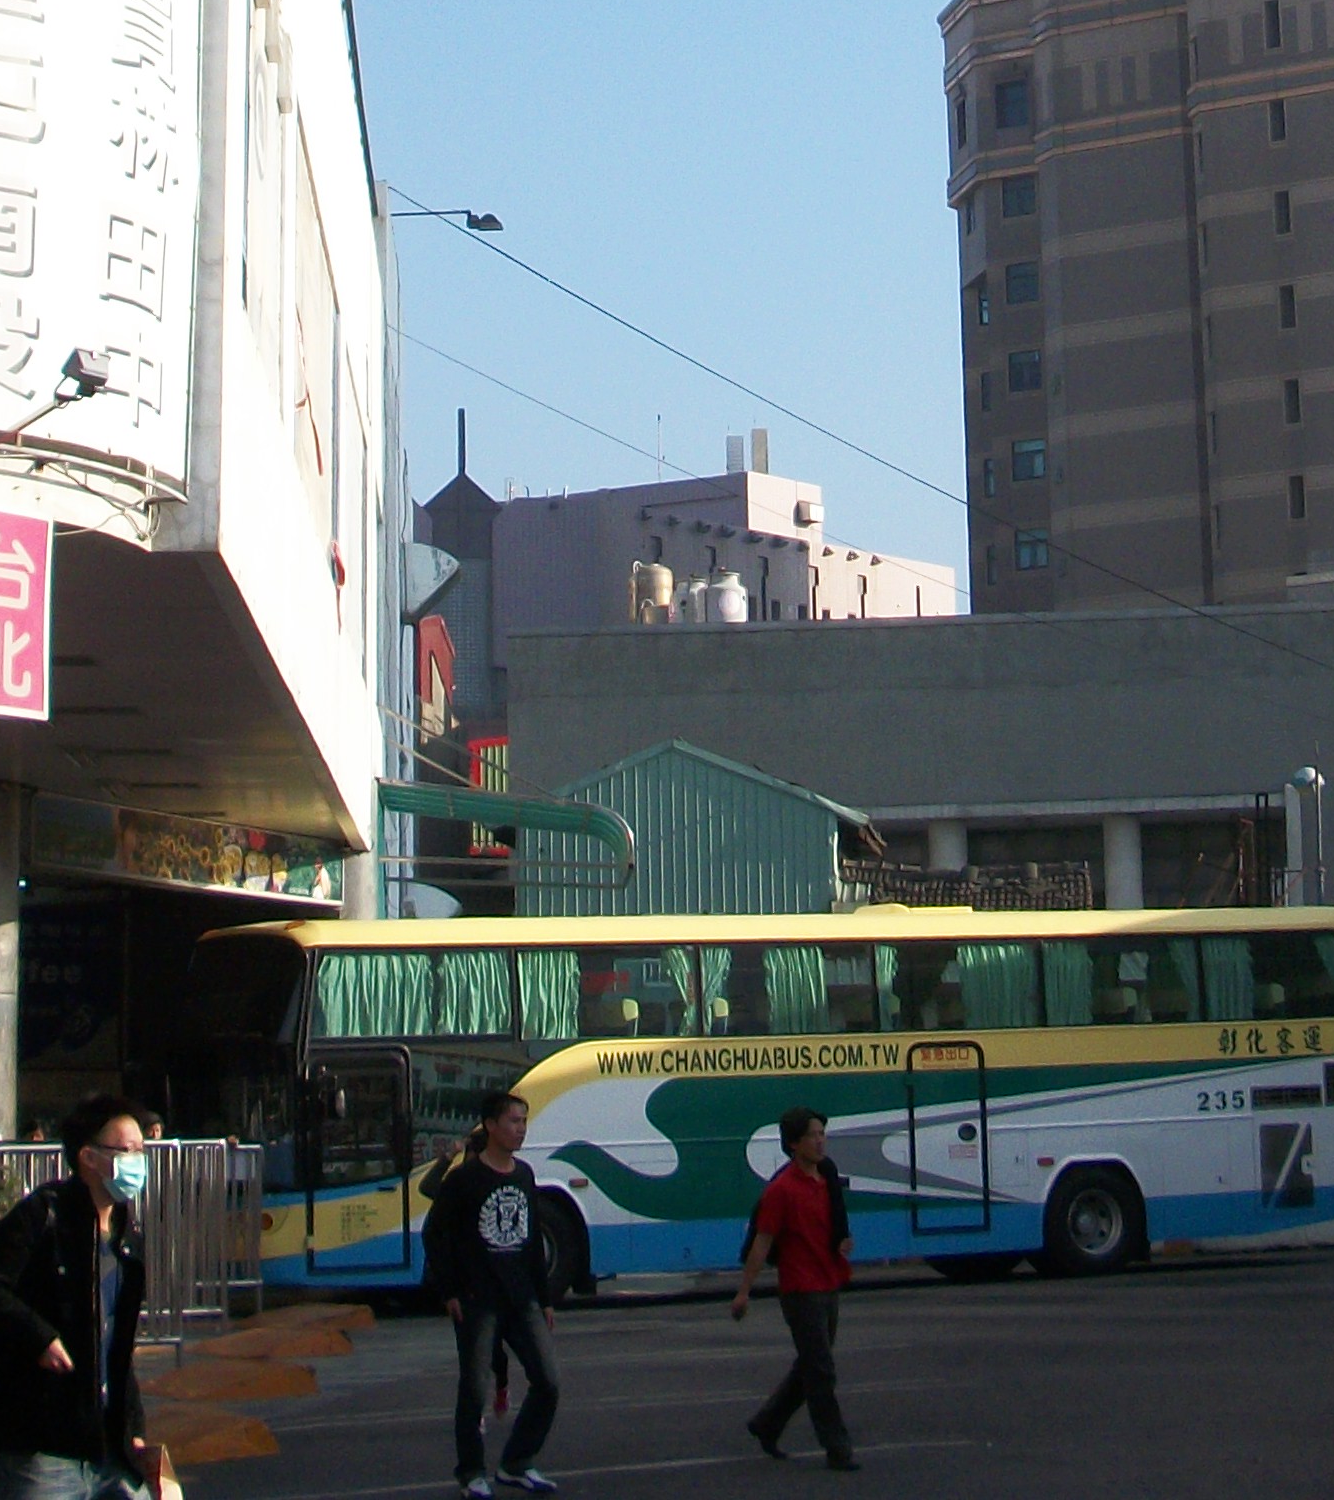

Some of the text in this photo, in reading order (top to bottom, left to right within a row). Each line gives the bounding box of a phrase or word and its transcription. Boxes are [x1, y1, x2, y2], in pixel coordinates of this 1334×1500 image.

[1218, 1024, 1325, 1056] 彰化客運
[597, 1043, 900, 1075] WWW.CHANGHUABUS.COM.TW
[919, 1047, 970, 1062] 緊急出口
[1196, 1090, 1246, 1113] 235
